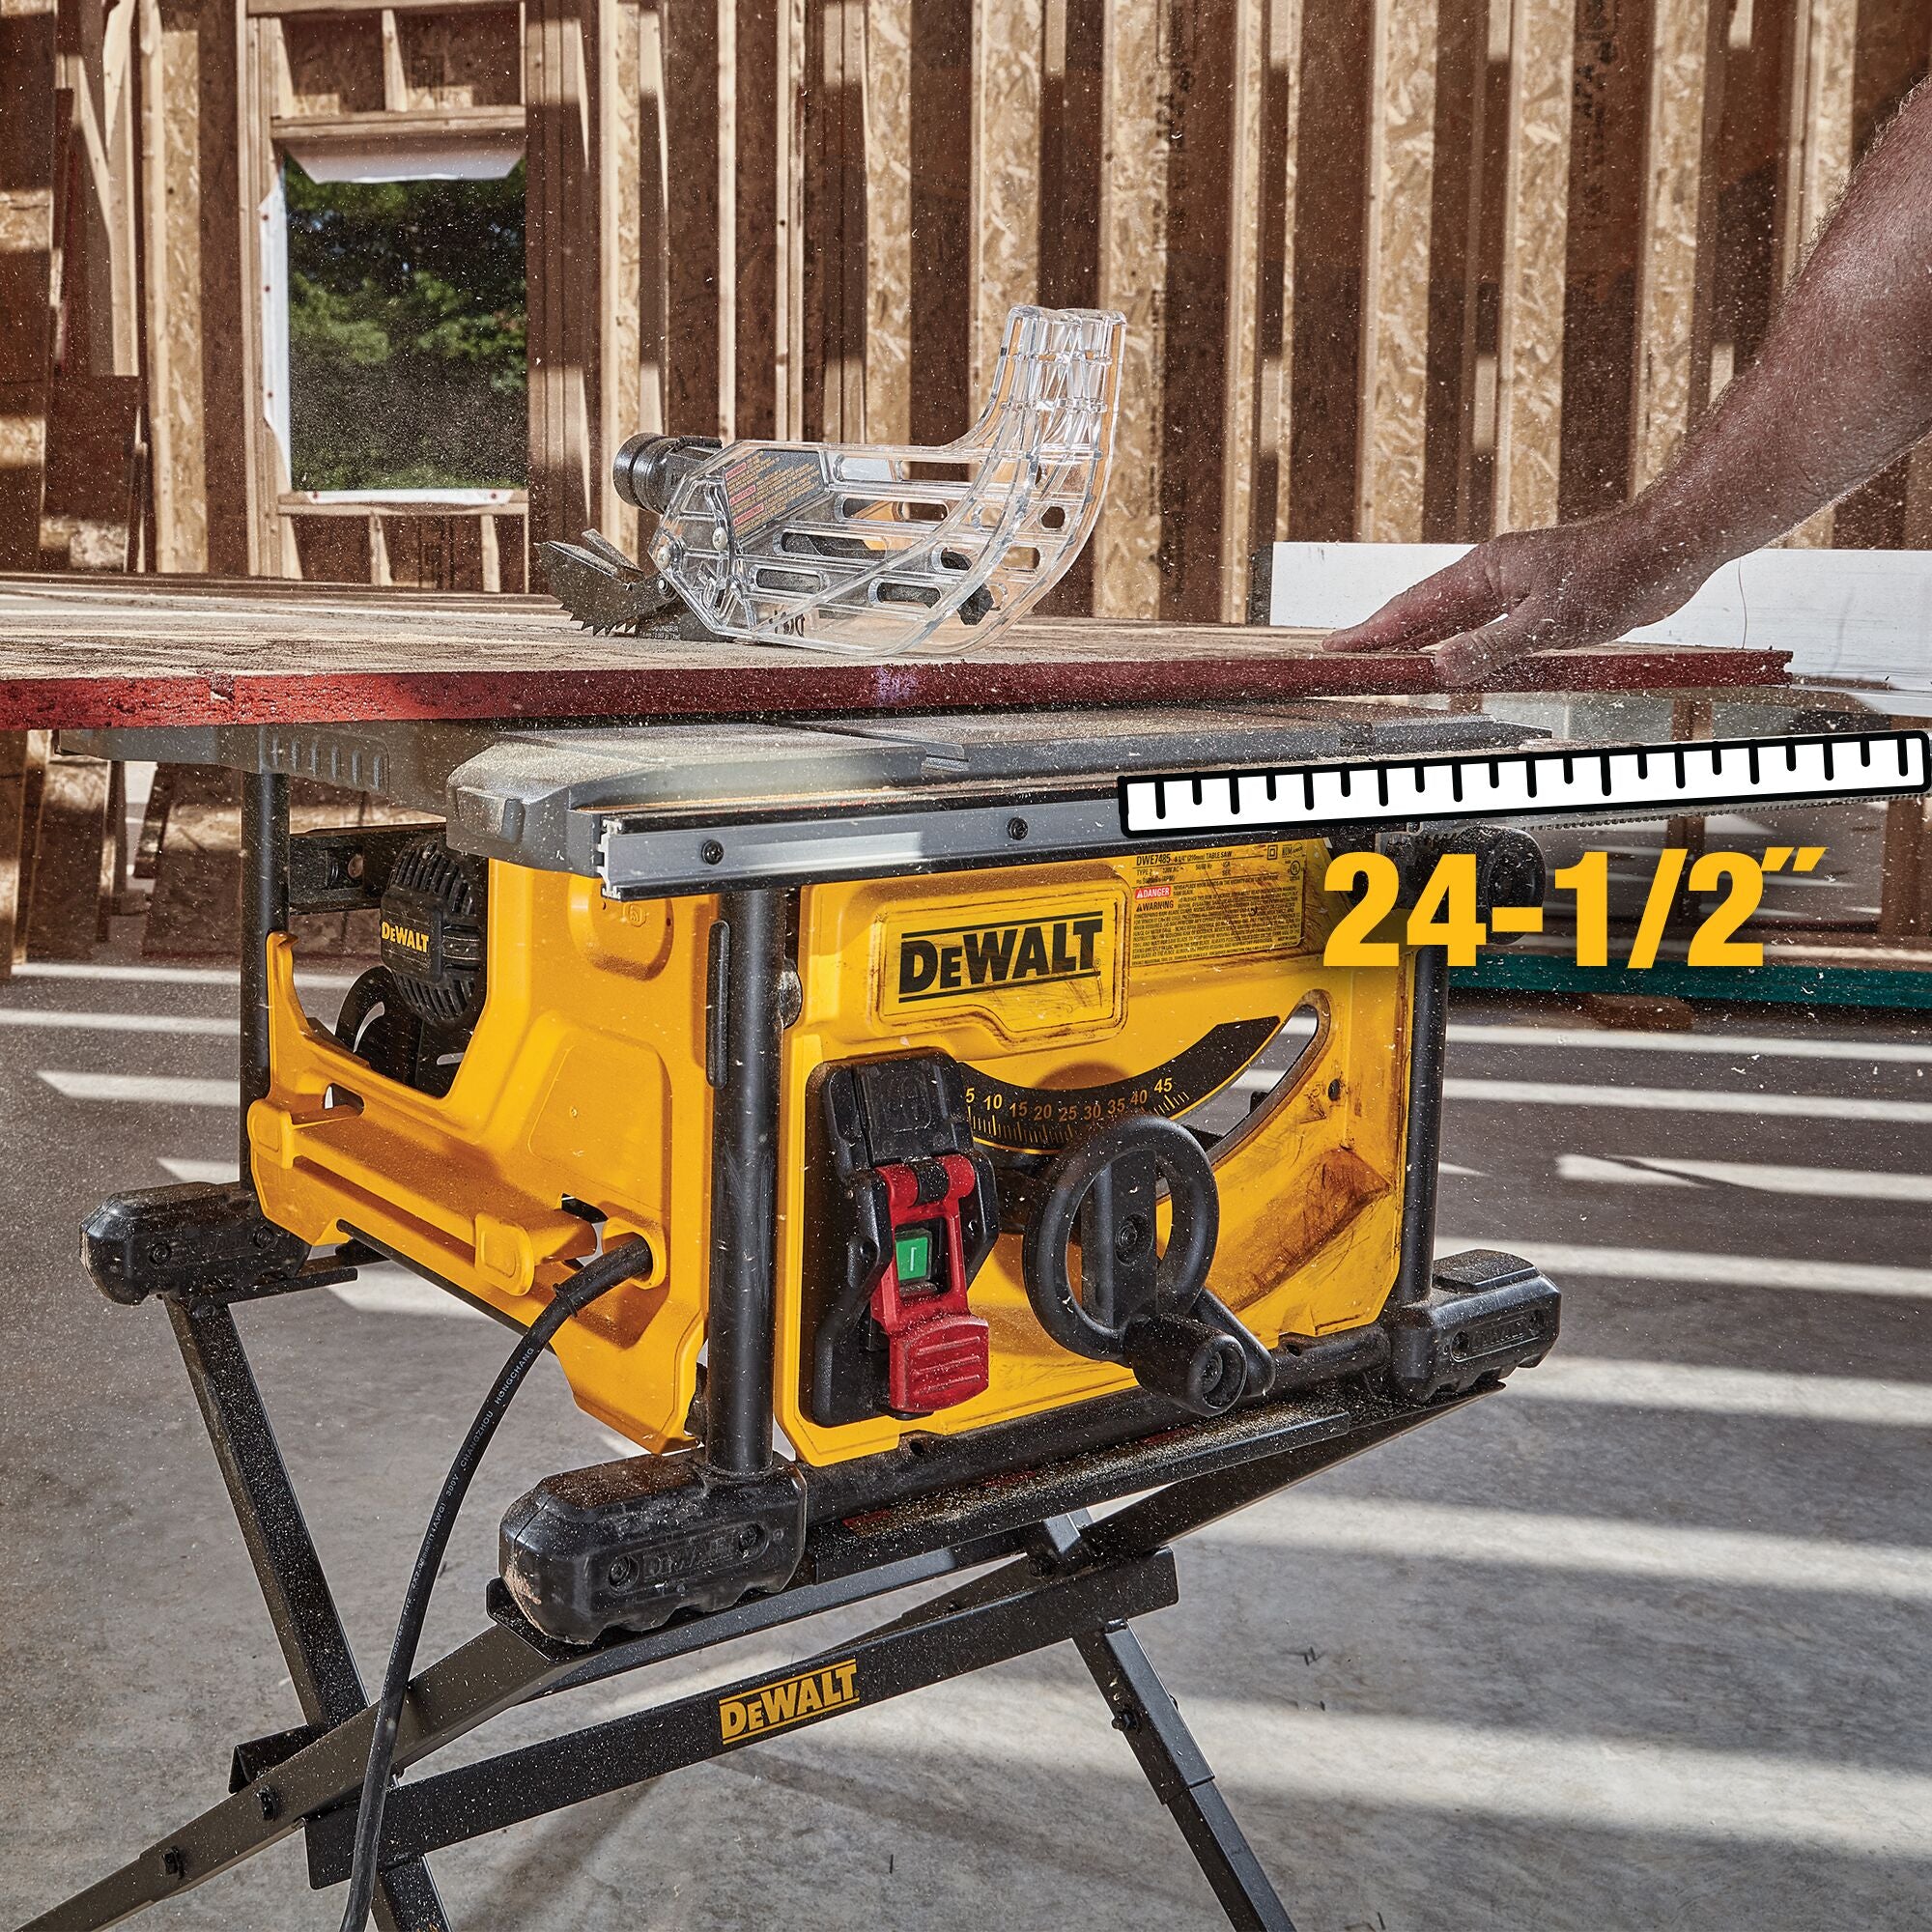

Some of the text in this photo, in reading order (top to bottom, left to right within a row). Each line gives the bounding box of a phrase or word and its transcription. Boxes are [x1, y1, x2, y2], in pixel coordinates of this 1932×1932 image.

[1136, 854, 1171, 867] DWE7485
[1220, 850, 1233, 859] SAW
[1143, 887, 1170, 898] DANGER
[1142, 899, 1174, 912] WARNING
[966, 1077, 1173, 1122] 5 10 15 20 25 30 35 40 45
[446, 1473, 460, 1497] 300V
[460, 1410, 494, 1467] CHANGZHOU
[494, 1348, 535, 1405] HONGCHANG
